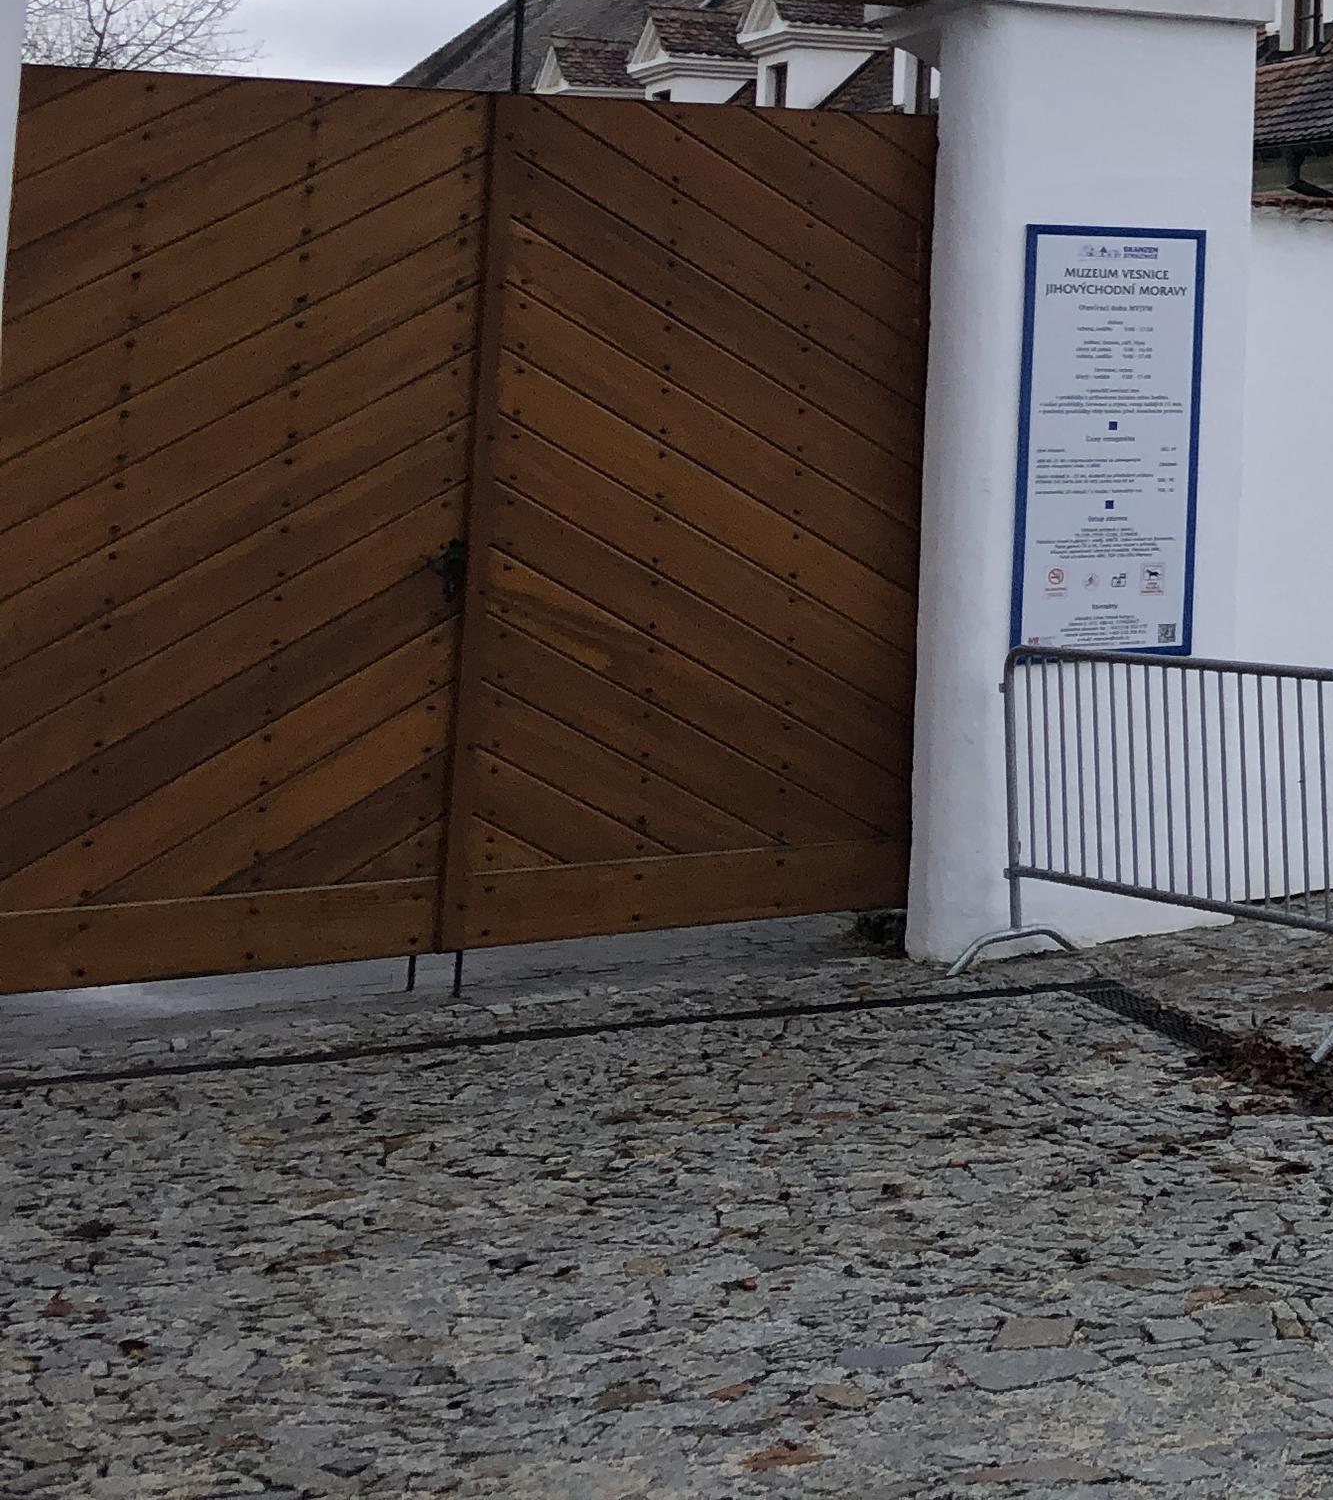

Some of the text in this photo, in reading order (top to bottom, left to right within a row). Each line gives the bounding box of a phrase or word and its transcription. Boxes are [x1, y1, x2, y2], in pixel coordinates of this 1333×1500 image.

[1064, 268, 1169, 280] MUZEUM VESNICE
[1045, 282, 1188, 296] JIHOVÝCHODNÍ MORAVY
